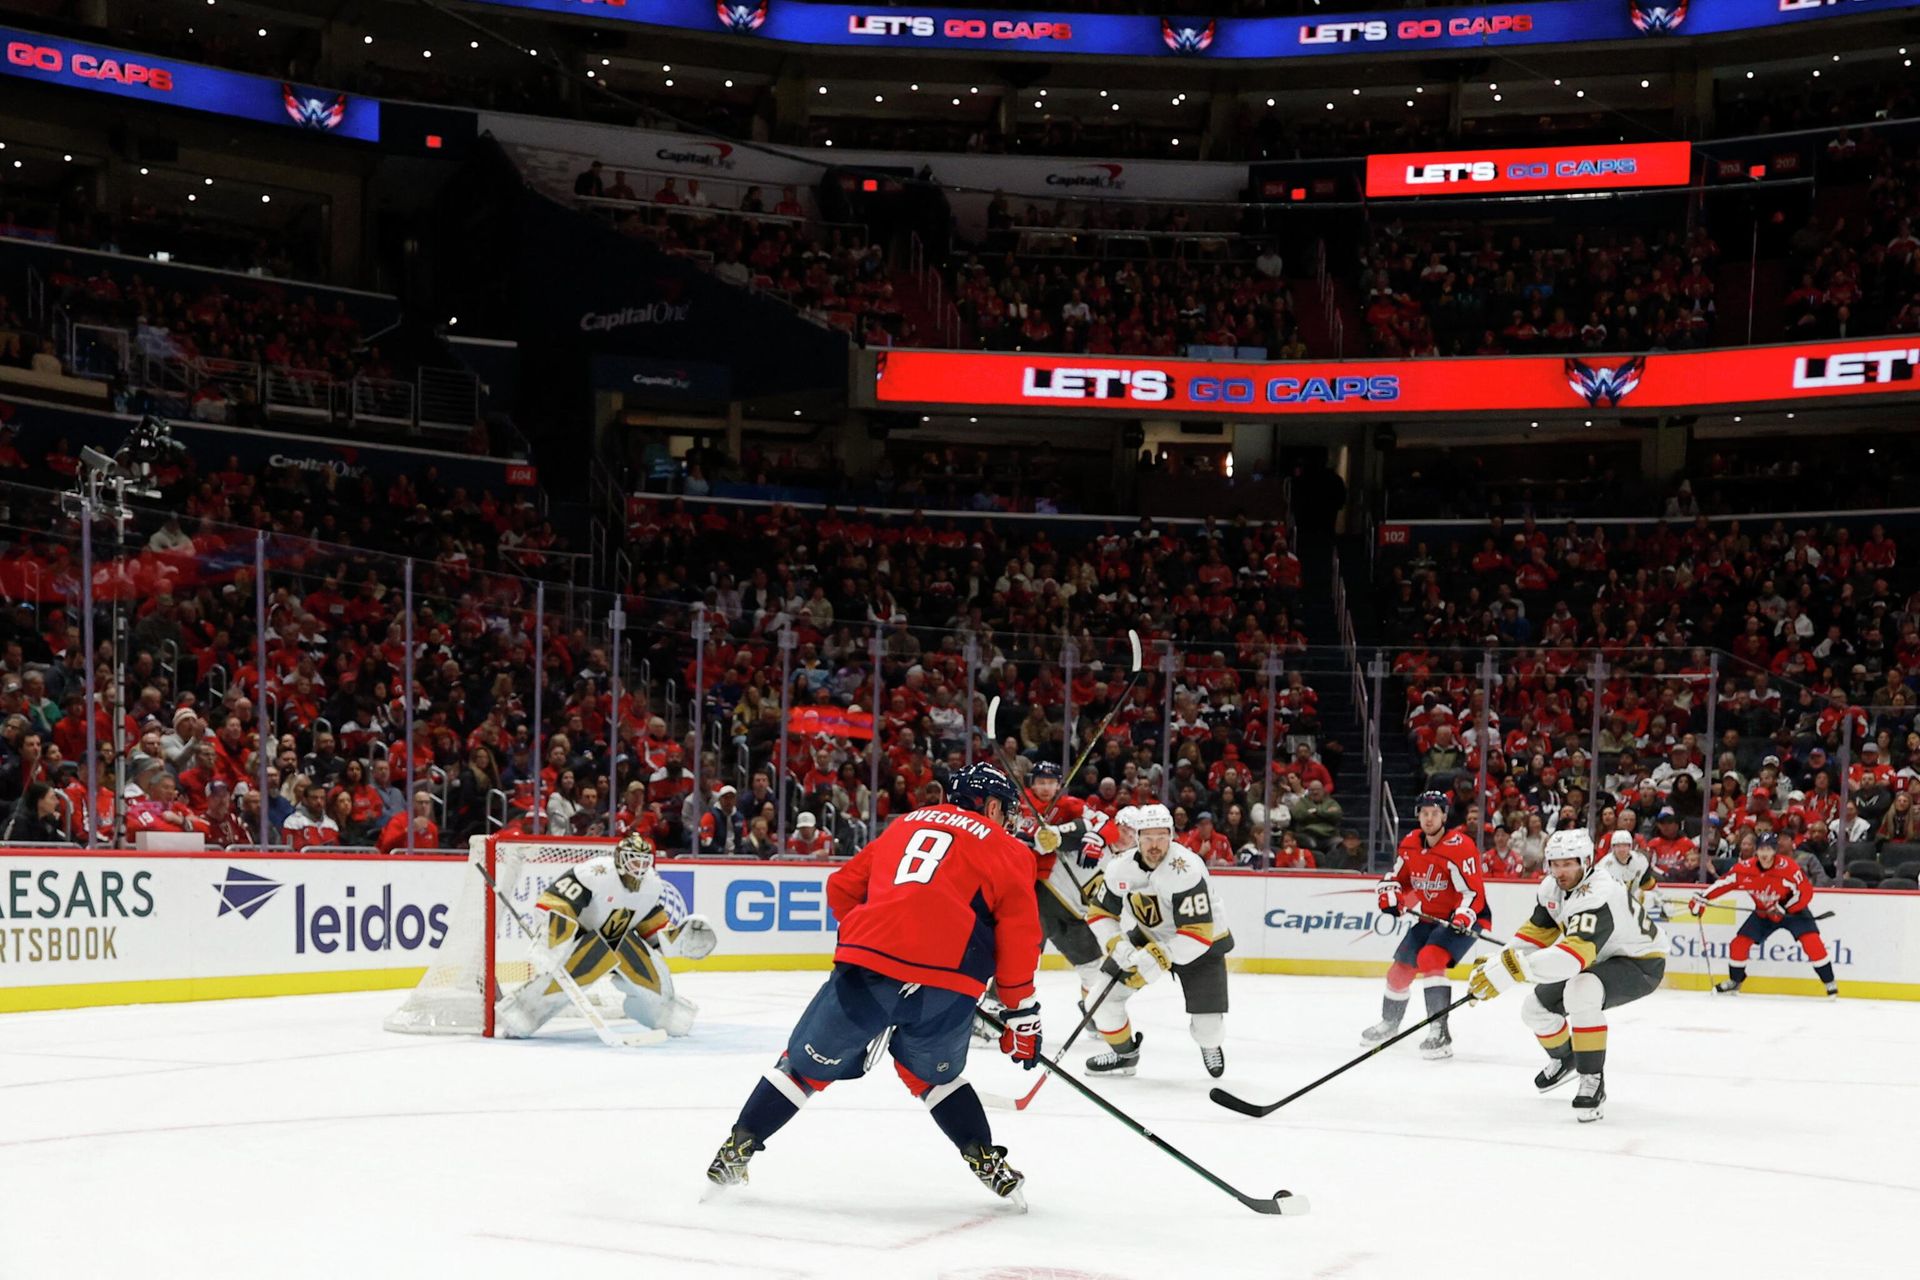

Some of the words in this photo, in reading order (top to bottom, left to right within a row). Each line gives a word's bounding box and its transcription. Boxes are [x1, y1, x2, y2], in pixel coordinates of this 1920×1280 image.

[849, 15, 934, 37] LET'S
[944, 20, 986, 38] GO
[993, 21, 1071, 40] CAPS
[1300, 20, 1387, 44] LET'S
[1397, 19, 1442, 38] GO
[1449, 14, 1533, 37] CAPS
[8, 42, 62, 72] GO
[72, 54, 174, 91] CAPS
[1405, 162, 1496, 184] LET'S
[1507, 163, 1549, 178] GO
[1556, 158, 1637, 177] CAPS
[1022, 366, 1169, 401] LET'S
[1188, 376, 1255, 403] GO
[1266, 375, 1400, 403] CAPS
[1384, 531, 1406, 543] 102
[904, 809, 992, 840] OVECHKIN
[895, 828, 953, 885] 8
[1462, 856, 1476, 875] 47
[0, 869, 155, 919] ESARS
[554, 876, 583, 901] 40
[1178, 892, 1210, 917] 48
[295, 883, 449, 954] leidos
[1565, 912, 1598, 936] 20
[1747, 938, 1854, 965] Heah
[804, 1043, 843, 1066] CCM
